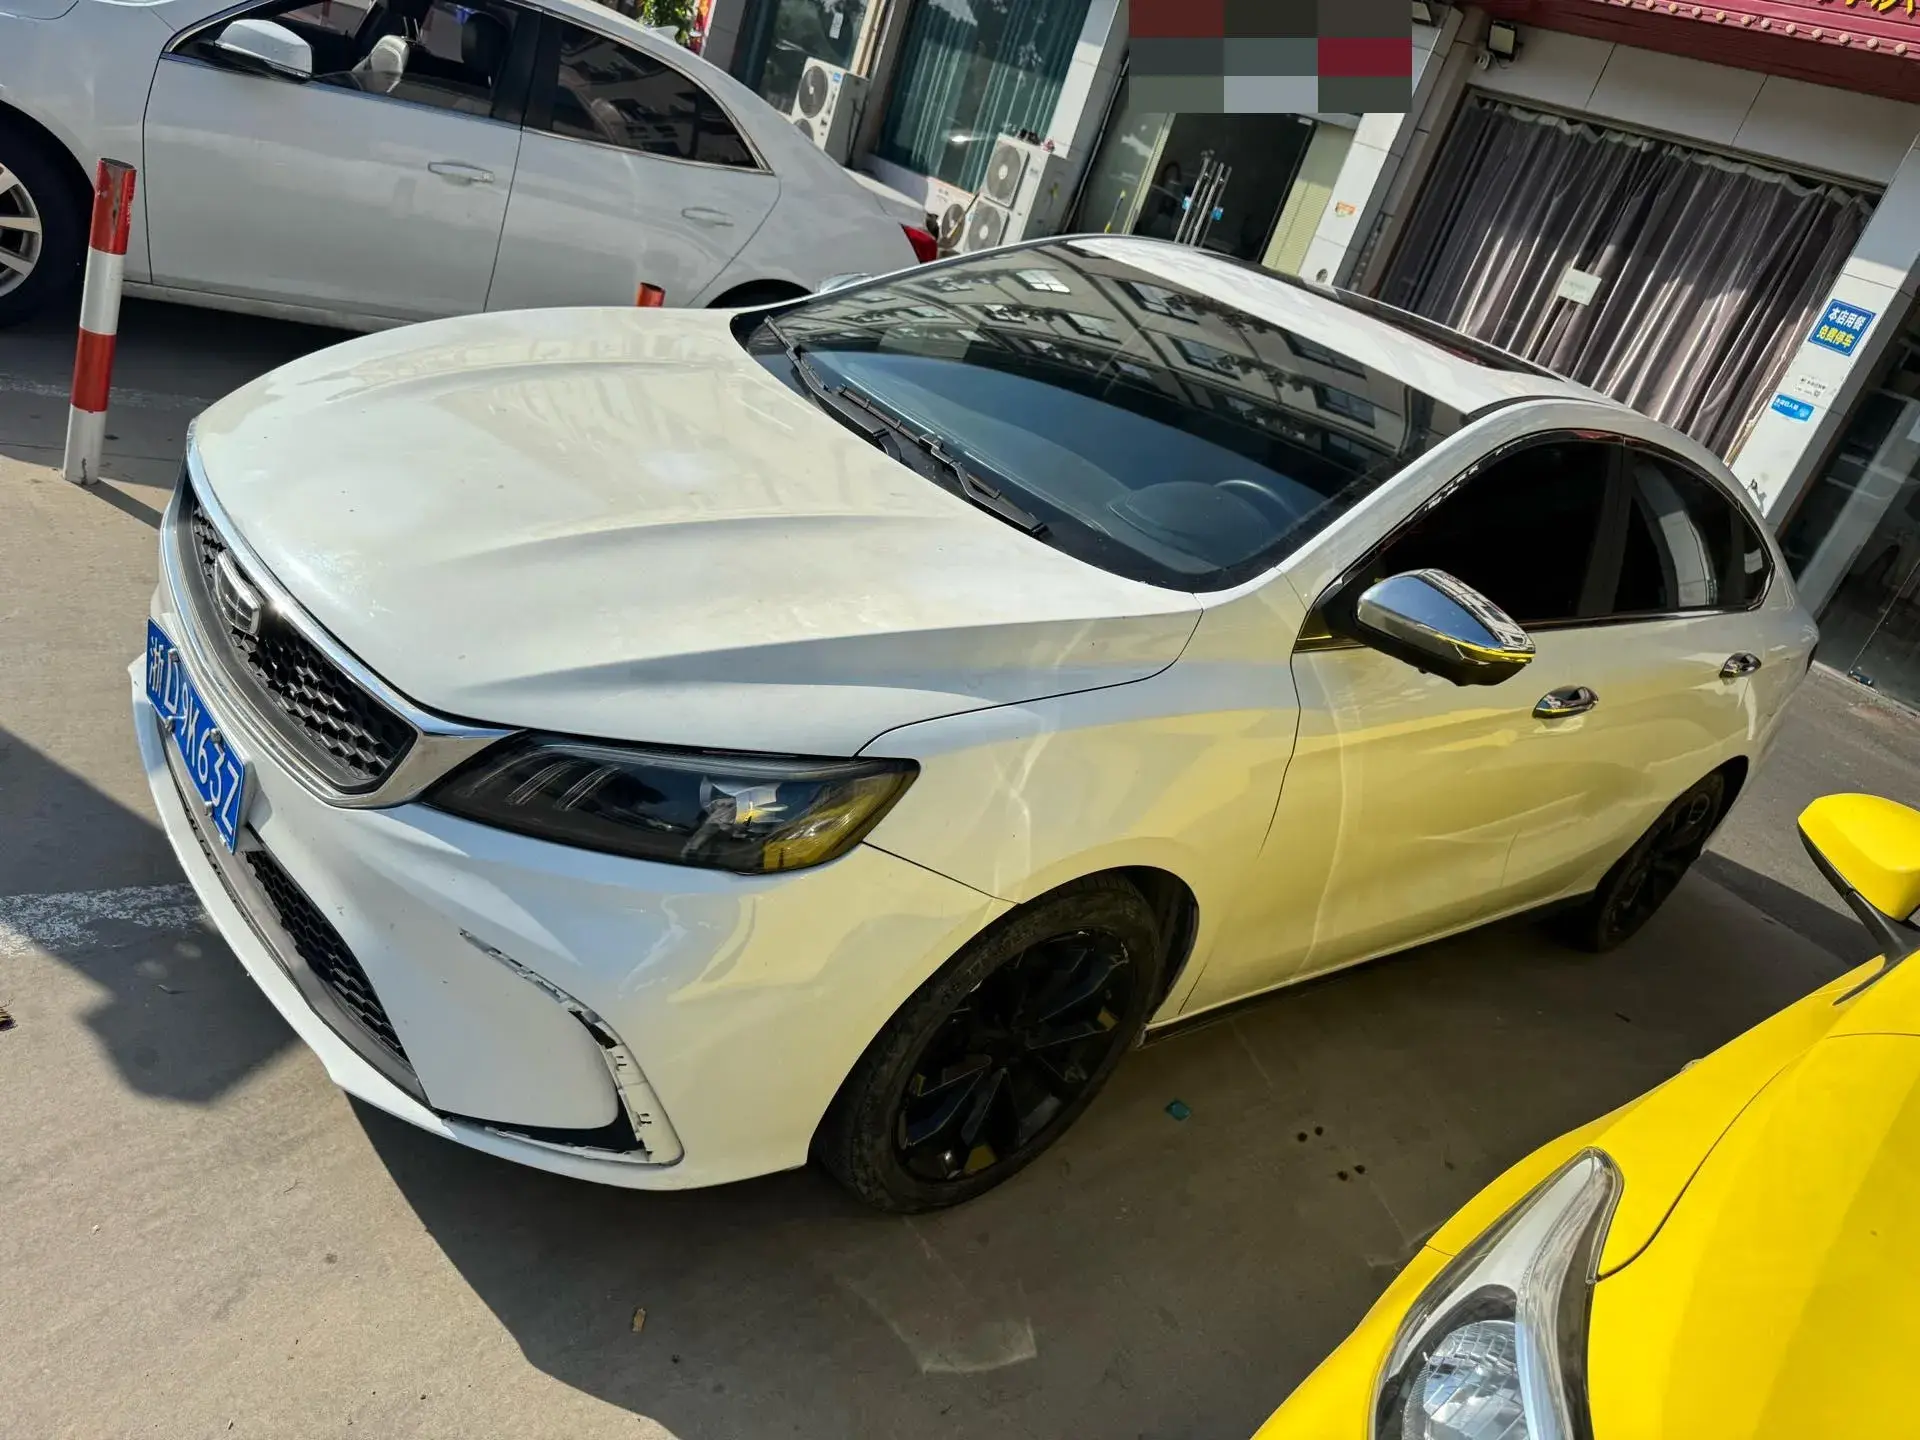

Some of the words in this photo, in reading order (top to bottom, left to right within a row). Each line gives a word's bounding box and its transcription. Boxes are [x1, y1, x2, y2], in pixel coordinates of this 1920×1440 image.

[1828, 307, 1867, 331] 本店用餐
[1816, 324, 1855, 348] 免费停车
